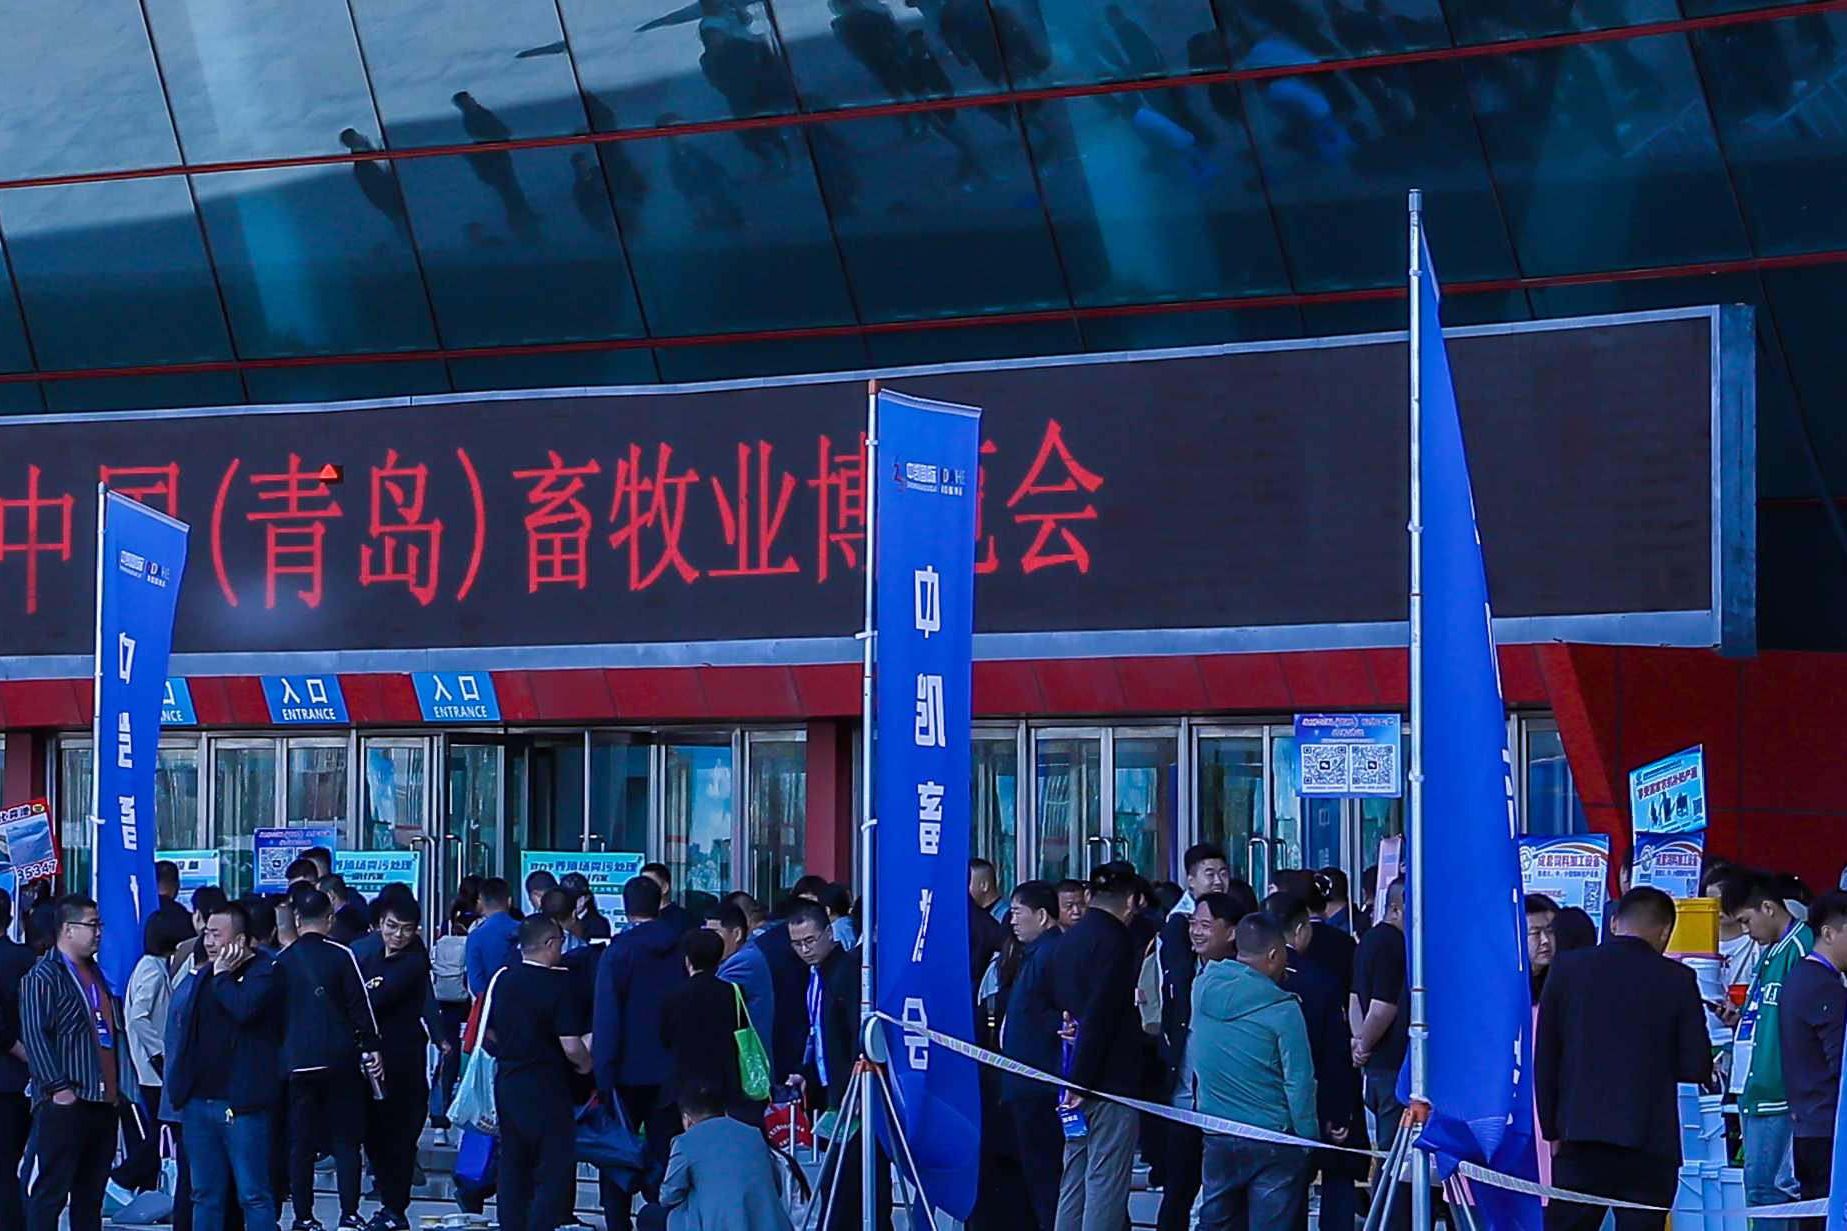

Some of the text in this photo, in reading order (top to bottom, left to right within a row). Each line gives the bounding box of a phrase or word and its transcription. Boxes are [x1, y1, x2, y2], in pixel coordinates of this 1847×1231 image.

[280, 677, 329, 705] 入口
[432, 674, 481, 702] 入口
[281, 707, 337, 721] ENTRANCE
[433, 705, 488, 718] ENTRANCE
